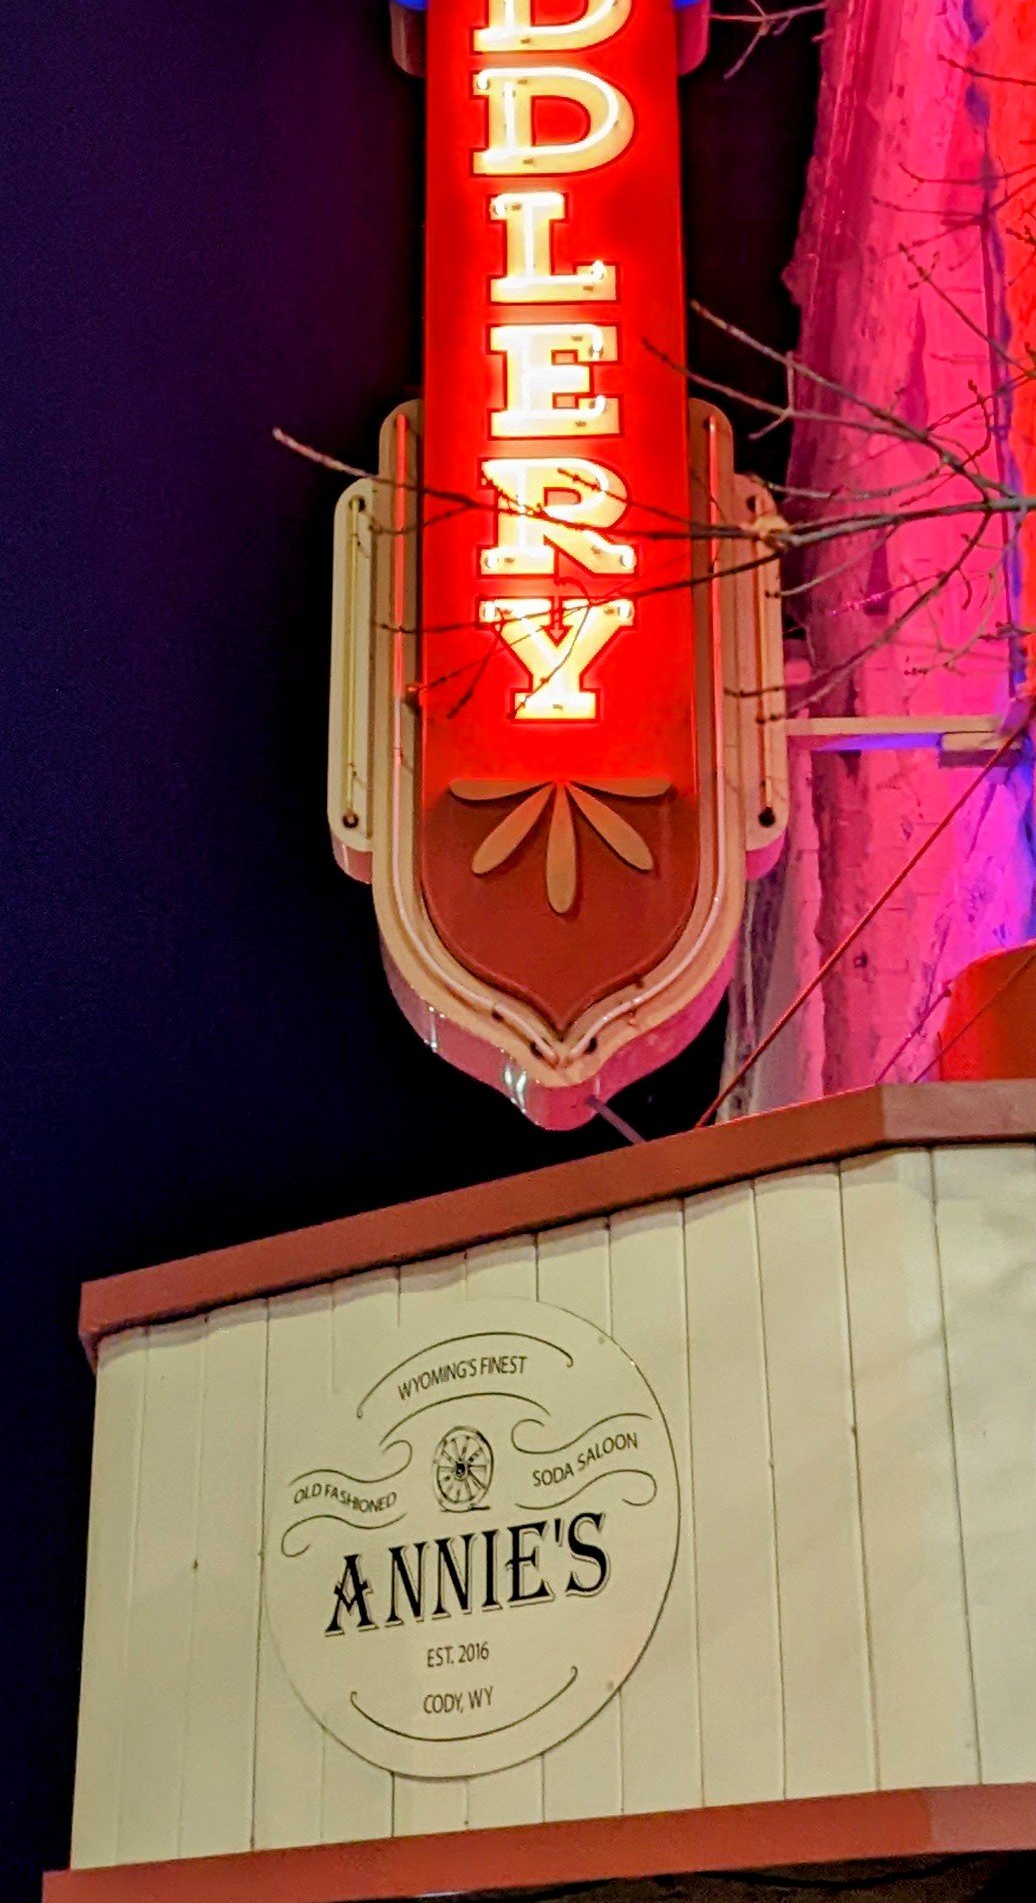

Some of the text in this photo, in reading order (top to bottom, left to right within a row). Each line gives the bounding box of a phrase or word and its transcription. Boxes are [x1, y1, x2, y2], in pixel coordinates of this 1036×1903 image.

[480, 1355, 528, 1375] FINEST
[532, 1432, 638, 1487] SODA SALOON
[293, 1483, 398, 1513] OLD FASHIONED
[324, 1512, 611, 1637] ANNIE'S
[427, 1640, 490, 1668] EST. 2016
[423, 1685, 494, 1714] CODY, WY
